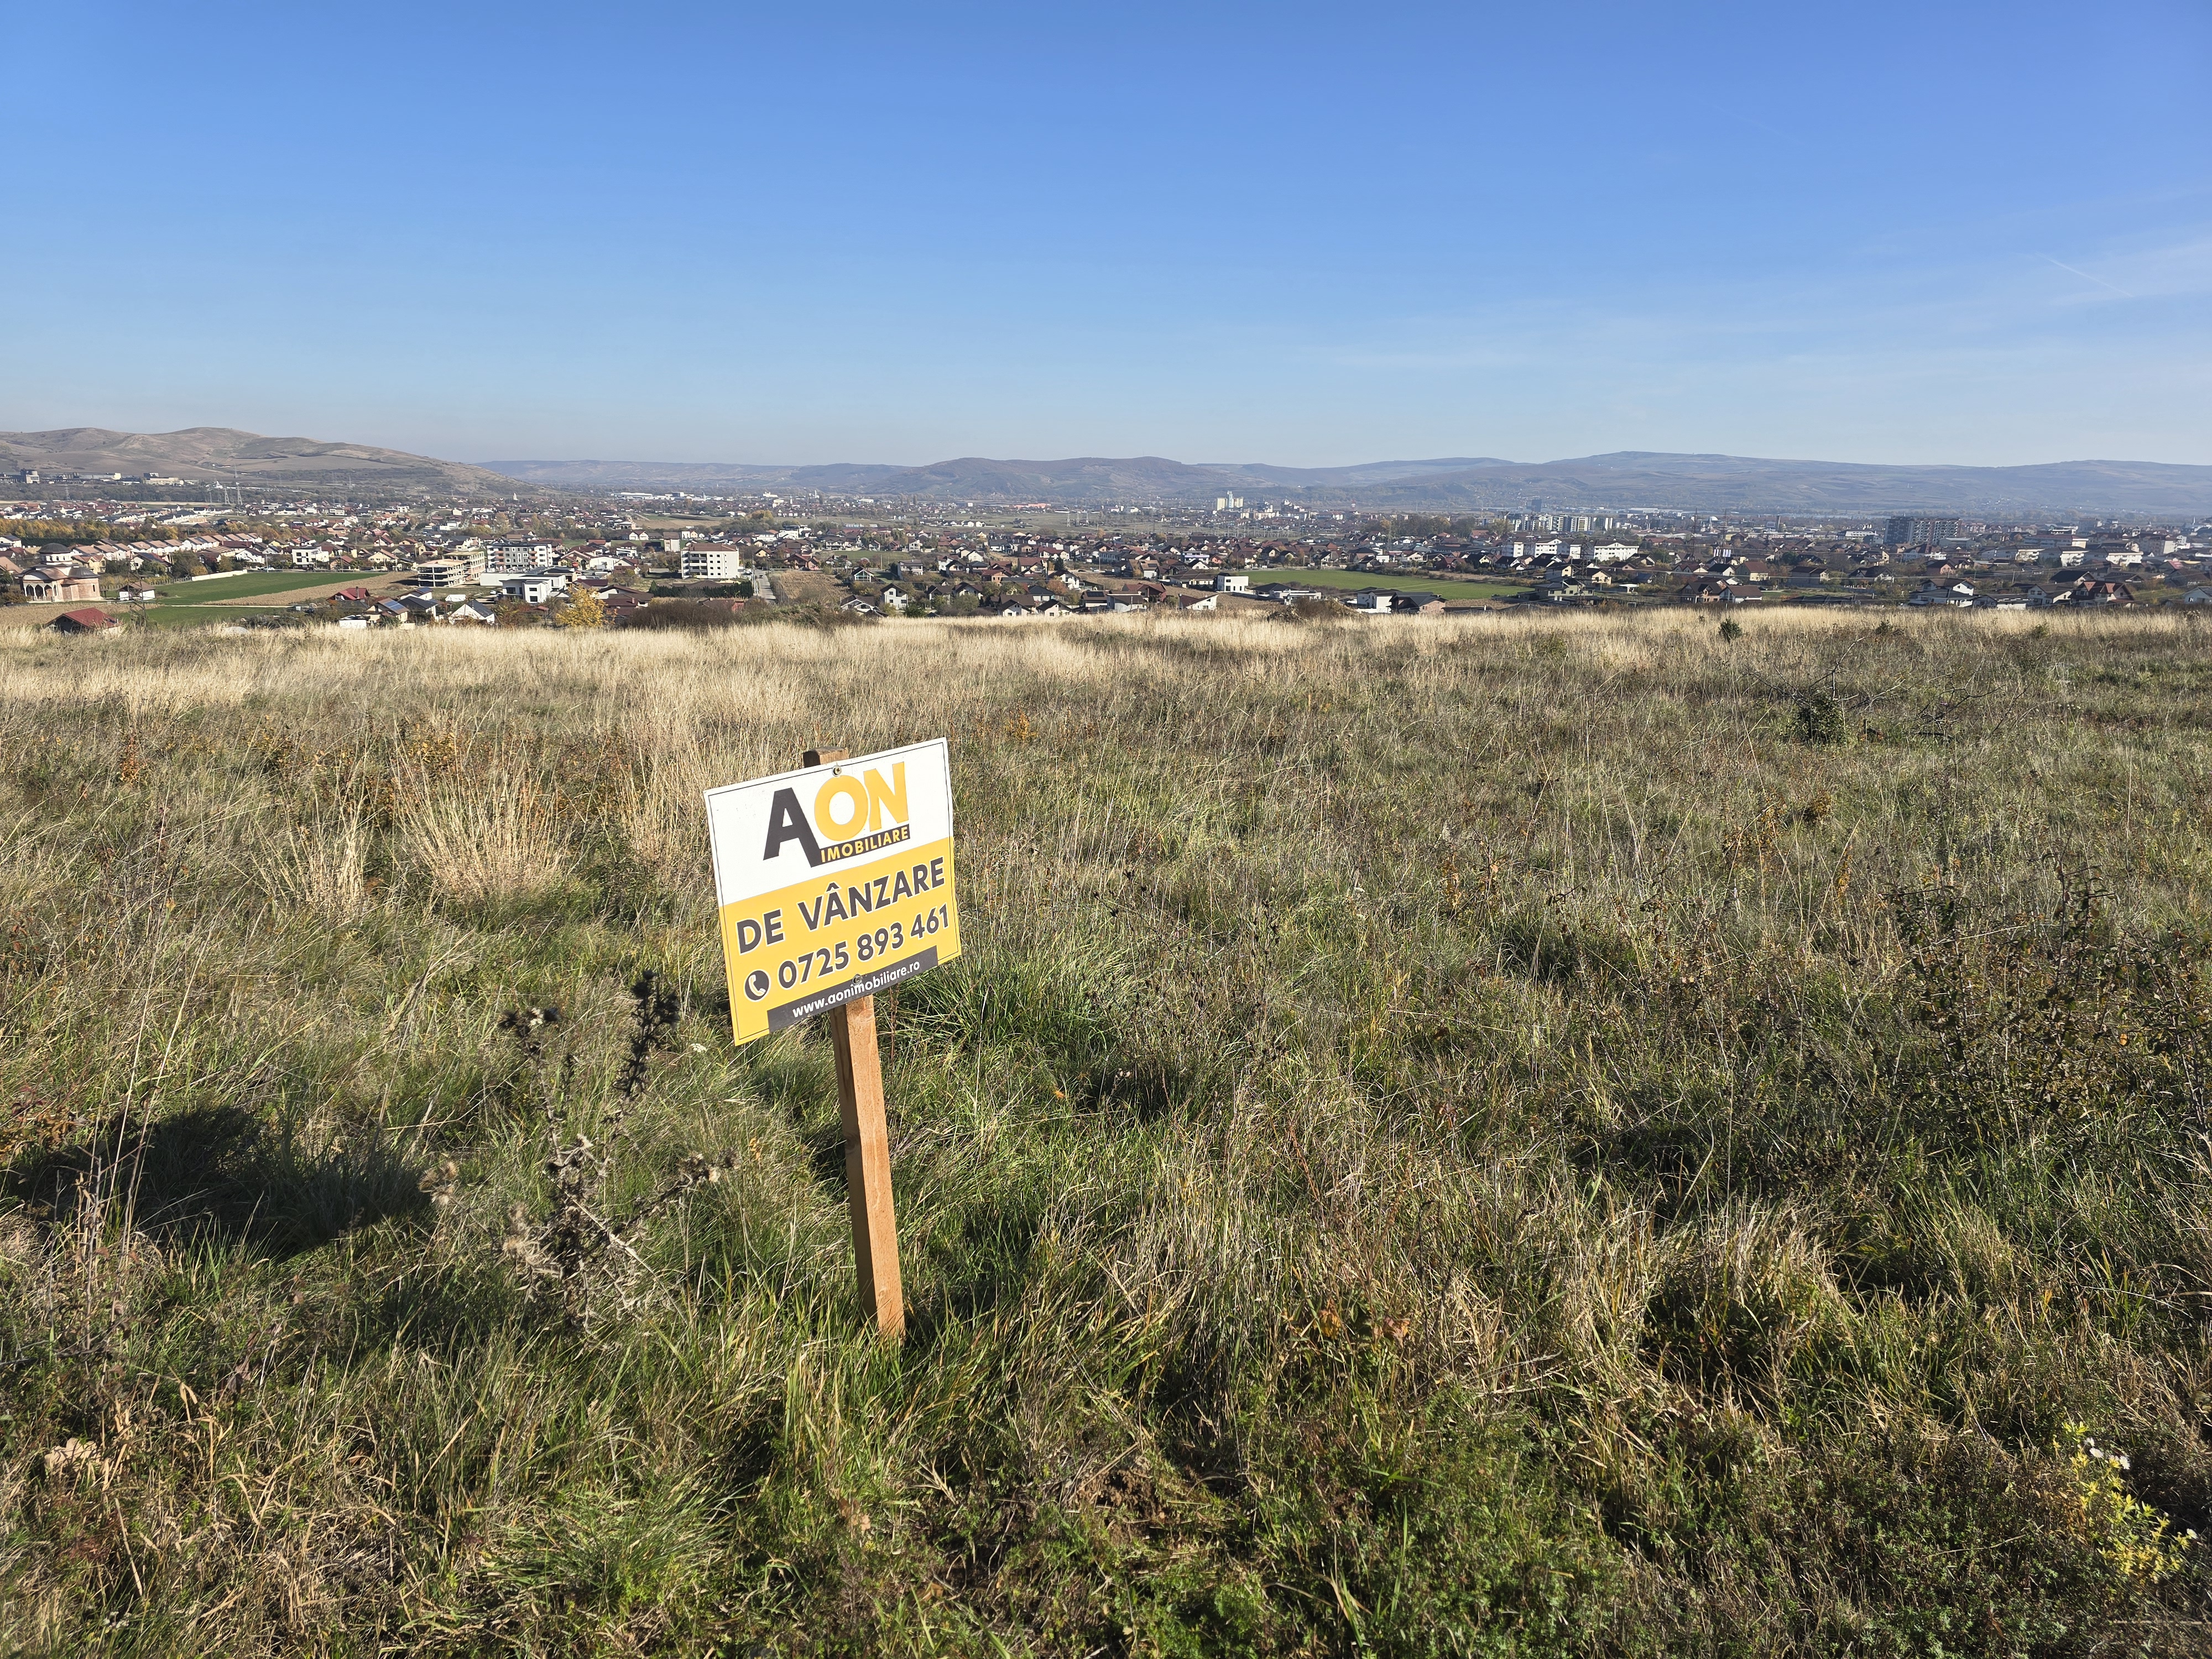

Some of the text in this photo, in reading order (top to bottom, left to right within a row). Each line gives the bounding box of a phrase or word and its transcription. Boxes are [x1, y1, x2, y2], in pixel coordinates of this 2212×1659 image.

[764, 761, 909, 868] AON
[821, 827, 909, 863] IMOBILIARE
[737, 857, 945, 953] DE VÂNZARE
[779, 904, 949, 988] 0725 893 461
[792, 961, 920, 1018] www.aonimobiliare.ro
